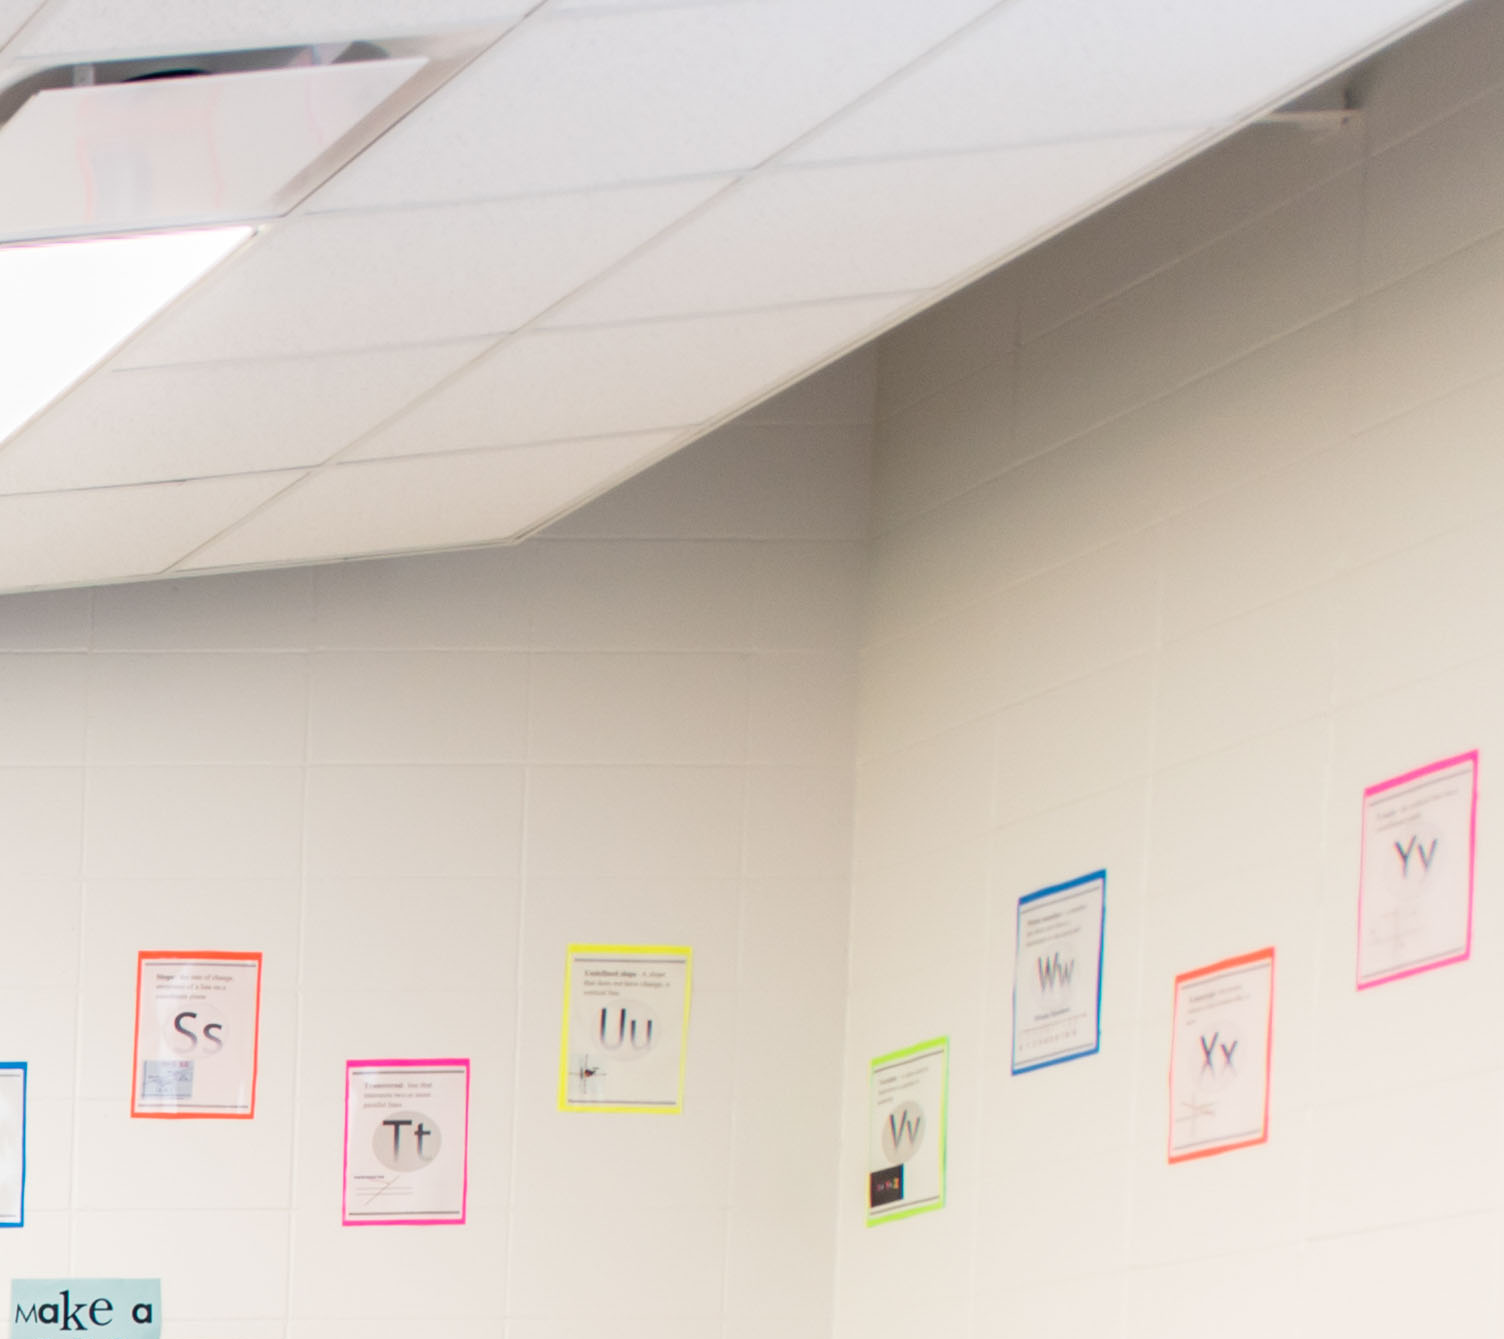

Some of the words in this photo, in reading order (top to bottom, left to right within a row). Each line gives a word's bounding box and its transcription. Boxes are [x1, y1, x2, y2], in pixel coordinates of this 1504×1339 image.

[173, 1011, 224, 1054] Ss
[599, 1007, 653, 1050] Uu
[381, 1119, 432, 1163] Tt
[888, 1109, 921, 1151] Vv
[14, 1290, 113, 1331] Make
[132, 1303, 152, 1324] a
